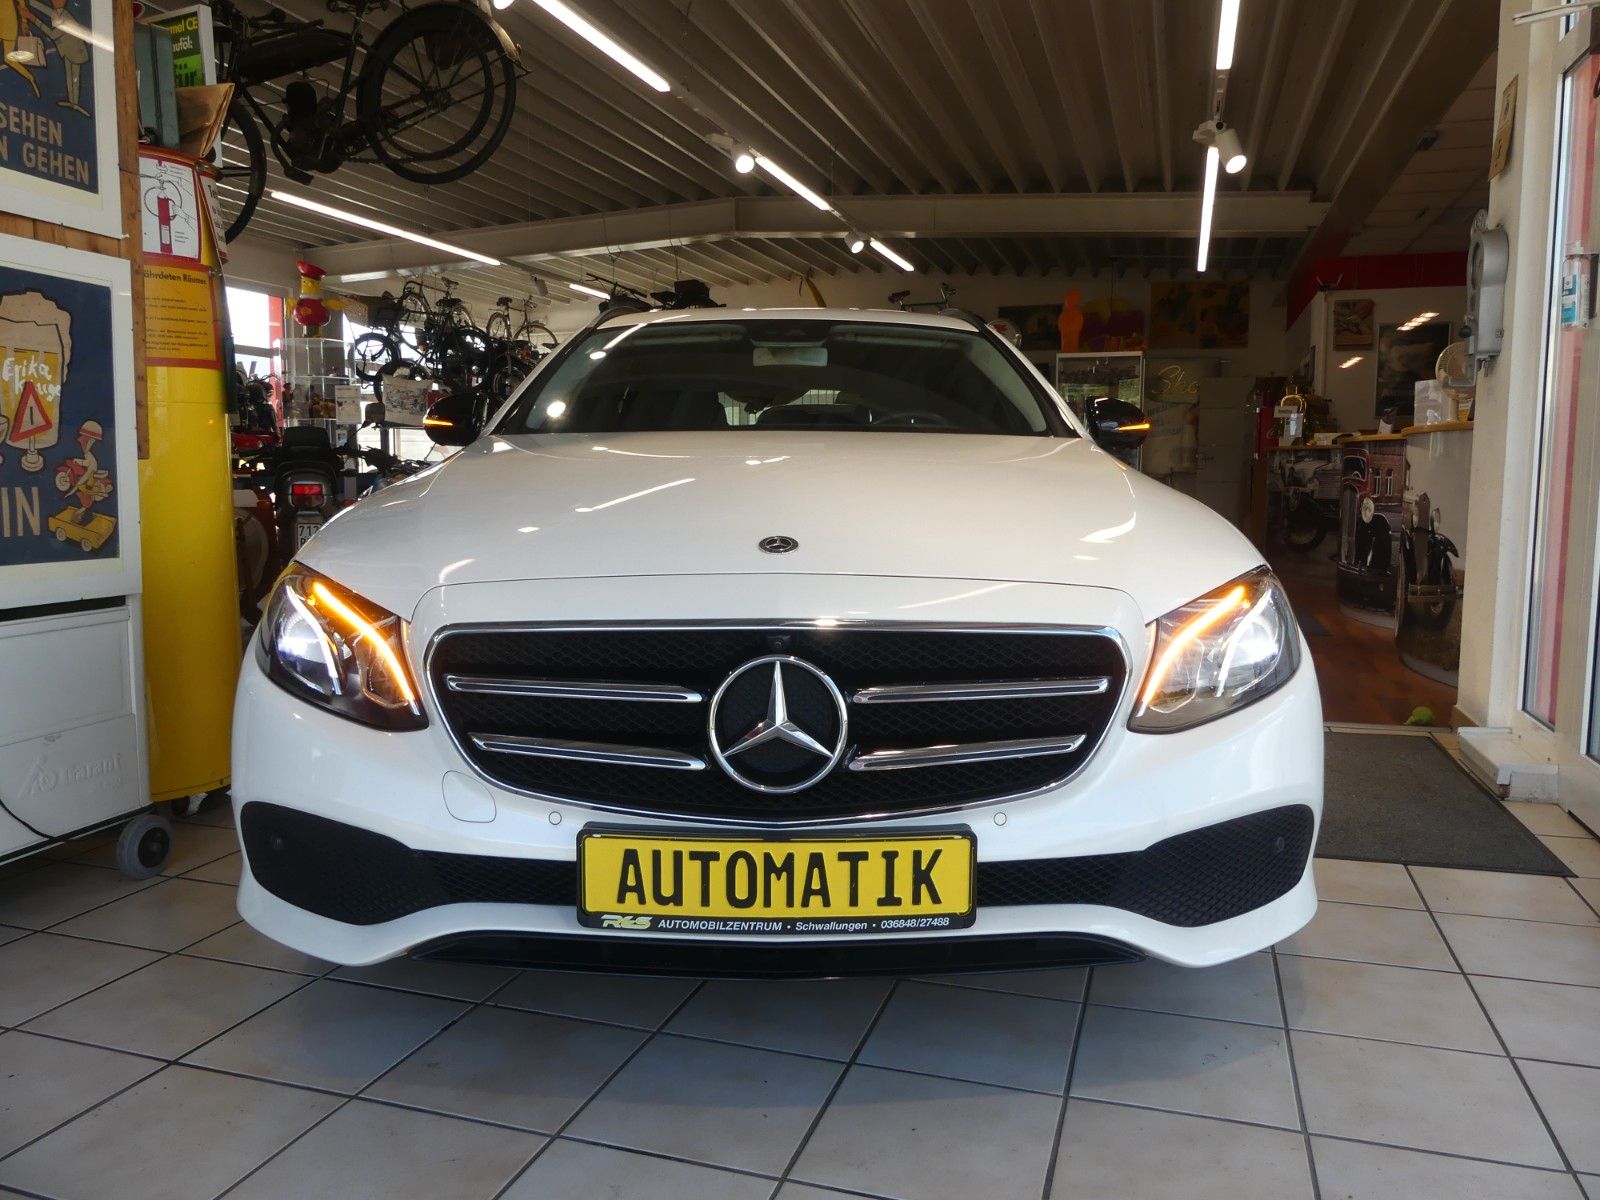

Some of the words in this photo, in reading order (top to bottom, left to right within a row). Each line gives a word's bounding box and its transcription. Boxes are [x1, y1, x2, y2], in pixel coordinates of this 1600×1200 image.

[0, 102, 63, 147] SEHEN
[22, 142, 90, 186] GEHEN
[616, 848, 943, 909] AUTOMATIK
[658, 918, 782, 931] AUTOMOBILZENTRUM
[795, 920, 868, 932] Schwallungen
[880, 916, 950, 930] 036848/27488
